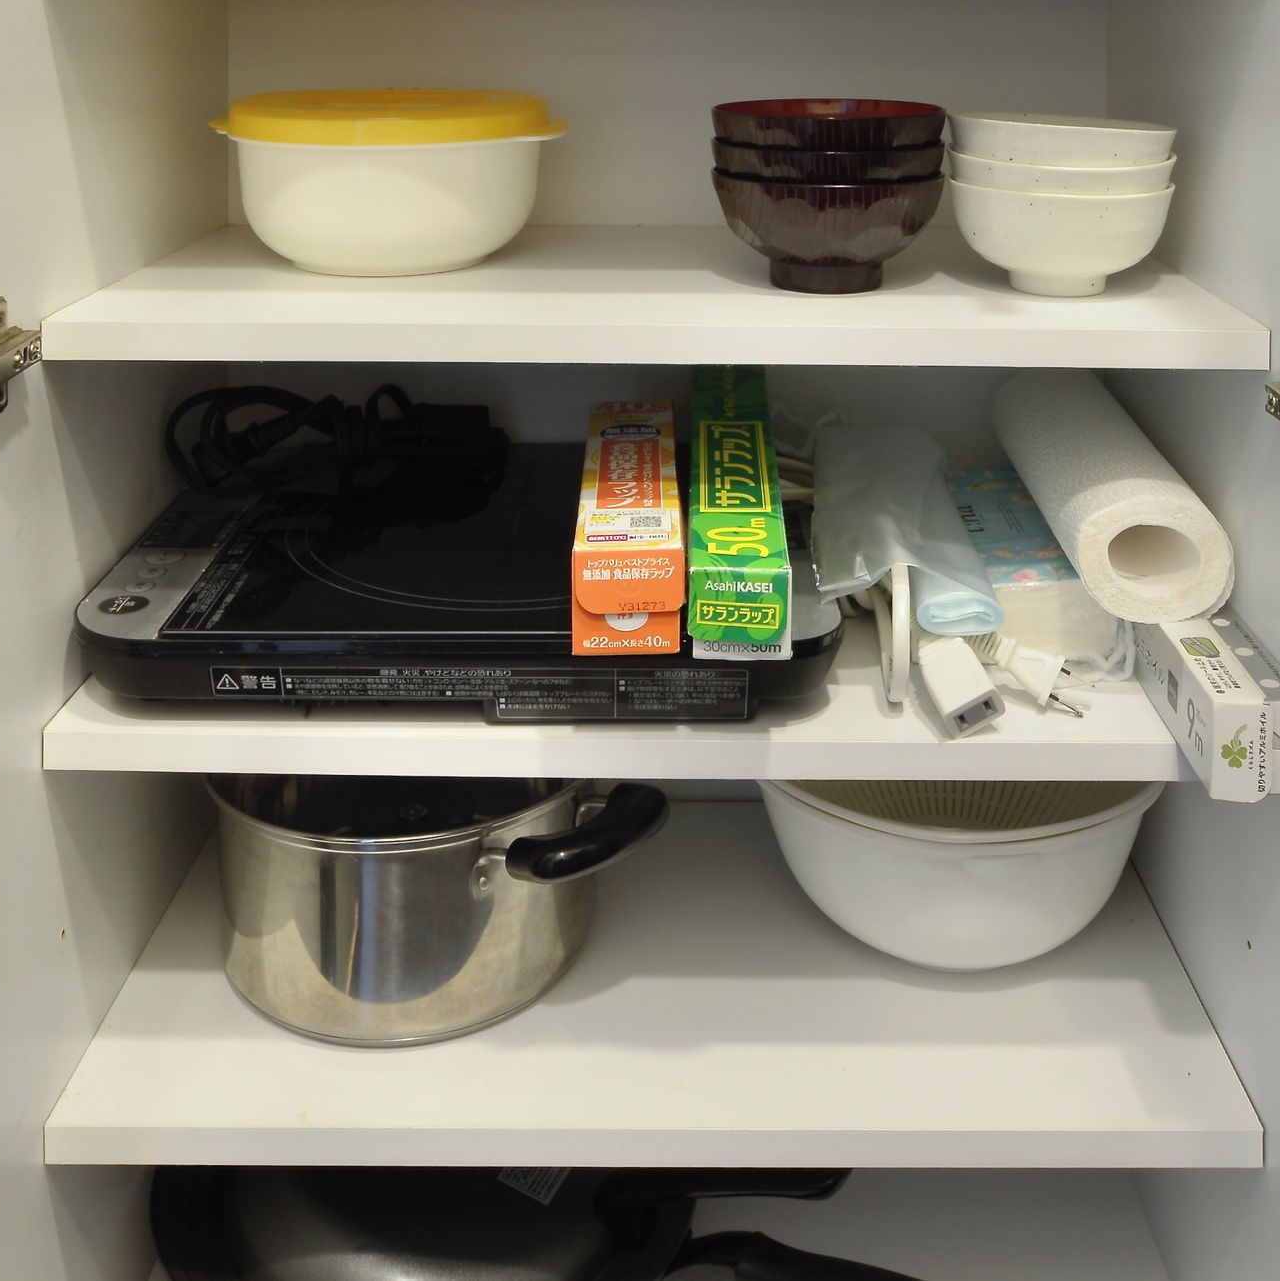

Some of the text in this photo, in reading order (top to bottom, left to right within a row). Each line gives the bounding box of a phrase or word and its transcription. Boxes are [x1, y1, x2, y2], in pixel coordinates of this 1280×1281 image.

[711, 425, 757, 507] サランラップ
[582, 566, 675, 581] 無添加 食品保存ラップ
[240, 674, 277, 689] 警告
[1257, 710, 1267, 793] 切りやすいアルミホイル
